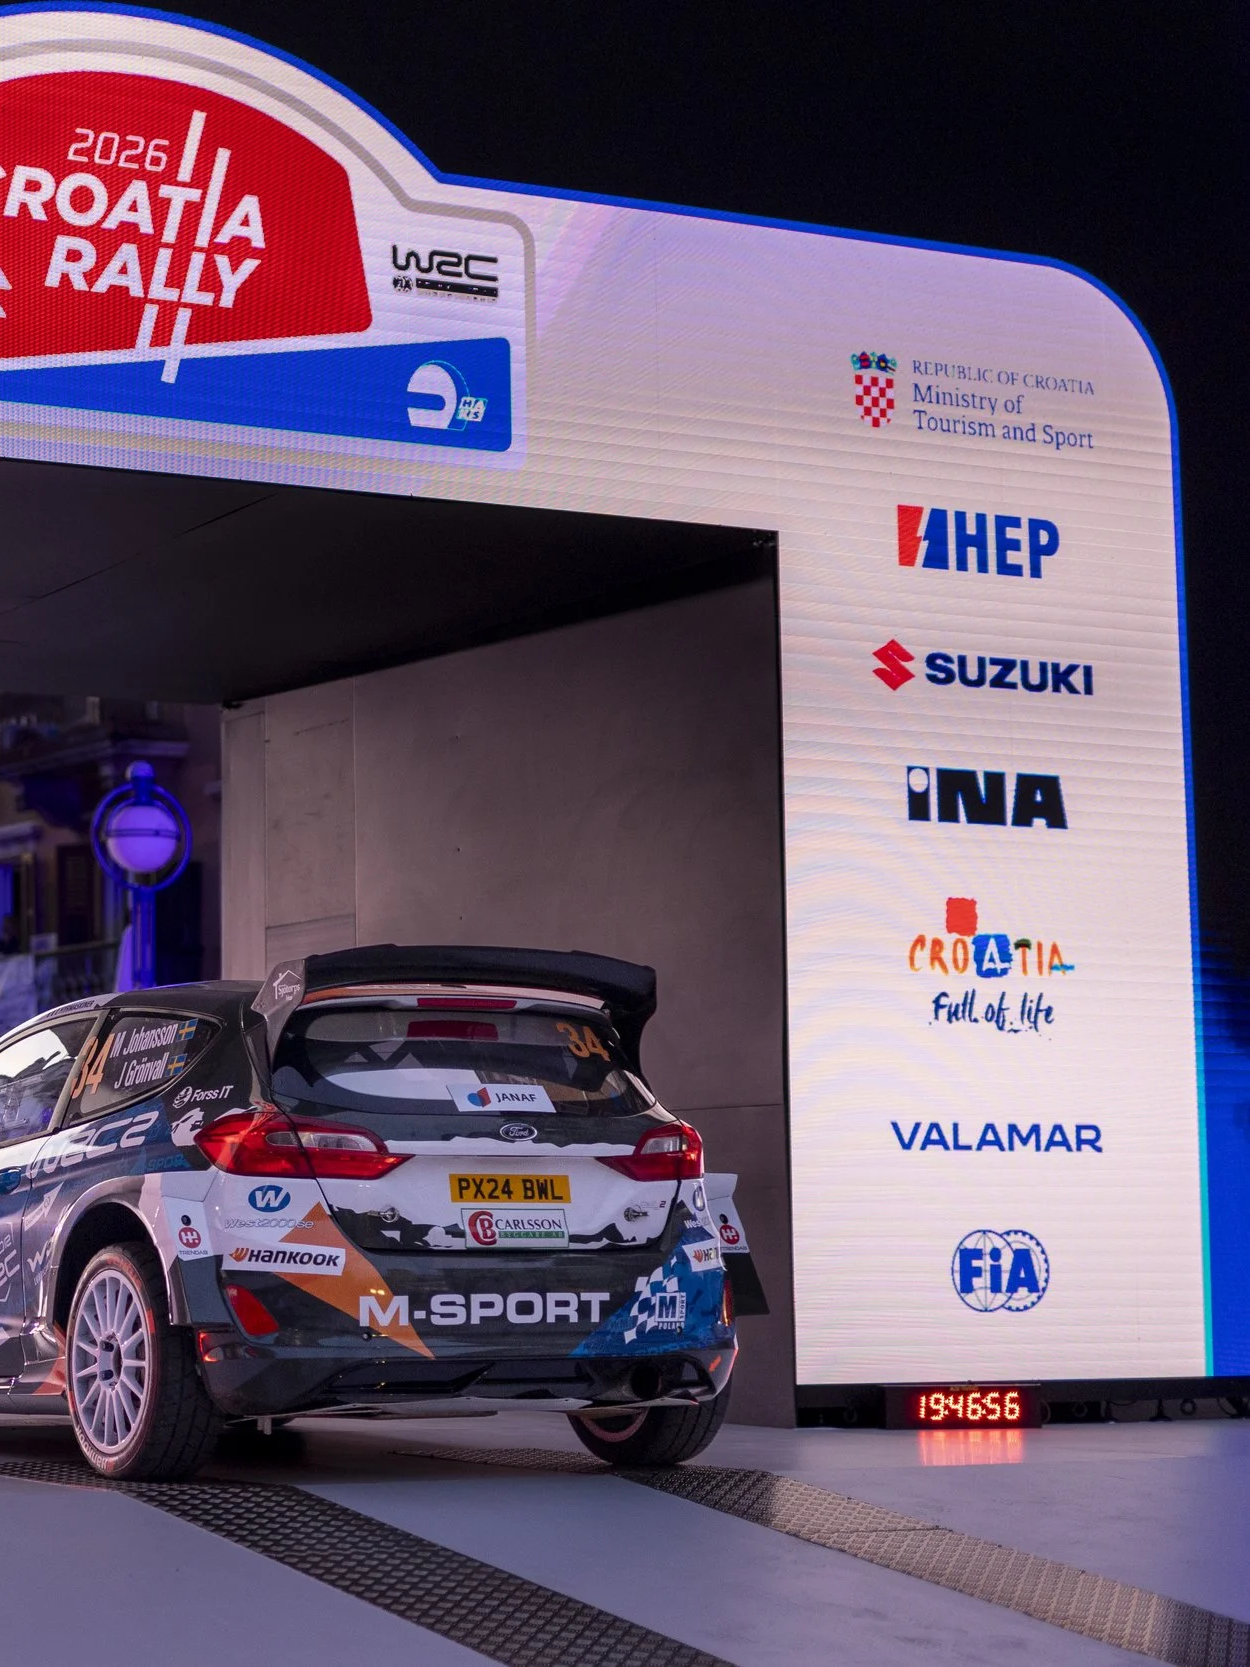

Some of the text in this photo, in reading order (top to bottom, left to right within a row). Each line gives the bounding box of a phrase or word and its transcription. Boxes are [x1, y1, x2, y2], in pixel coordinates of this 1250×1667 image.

[67, 127, 170, 172] 2026
[45, 235, 262, 309] RALLY
[392, 245, 499, 282] WRC
[912, 359, 1095, 396] REPUBLIC OF CROATIA
[913, 383, 1025, 415] Ministry of
[913, 410, 1095, 450] Tourism and Sport
[954, 510, 1060, 579] HEP
[925, 652, 1094, 696] SUZUKI
[908, 934, 1074, 978] CROATIA
[931, 988, 1055, 1033] Full of life
[110, 1023, 178, 1059] M Johansson
[556, 1022, 611, 1062] 34
[71, 1033, 115, 1099] 34
[114, 1051, 170, 1089] J Grönvall
[191, 1085, 234, 1102] Forss IT
[495, 1092, 537, 1103] JANAF
[508, 1125, 530, 1137] Ford
[890, 1120, 1104, 1153] VALAMAR
[457, 1177, 564, 1201] PX24 BWL
[495, 1218, 563, 1231] CARLSSON
[498, 1230, 565, 1239] BYGGARE AB
[359, 1292, 611, 1328] M-SPORT
